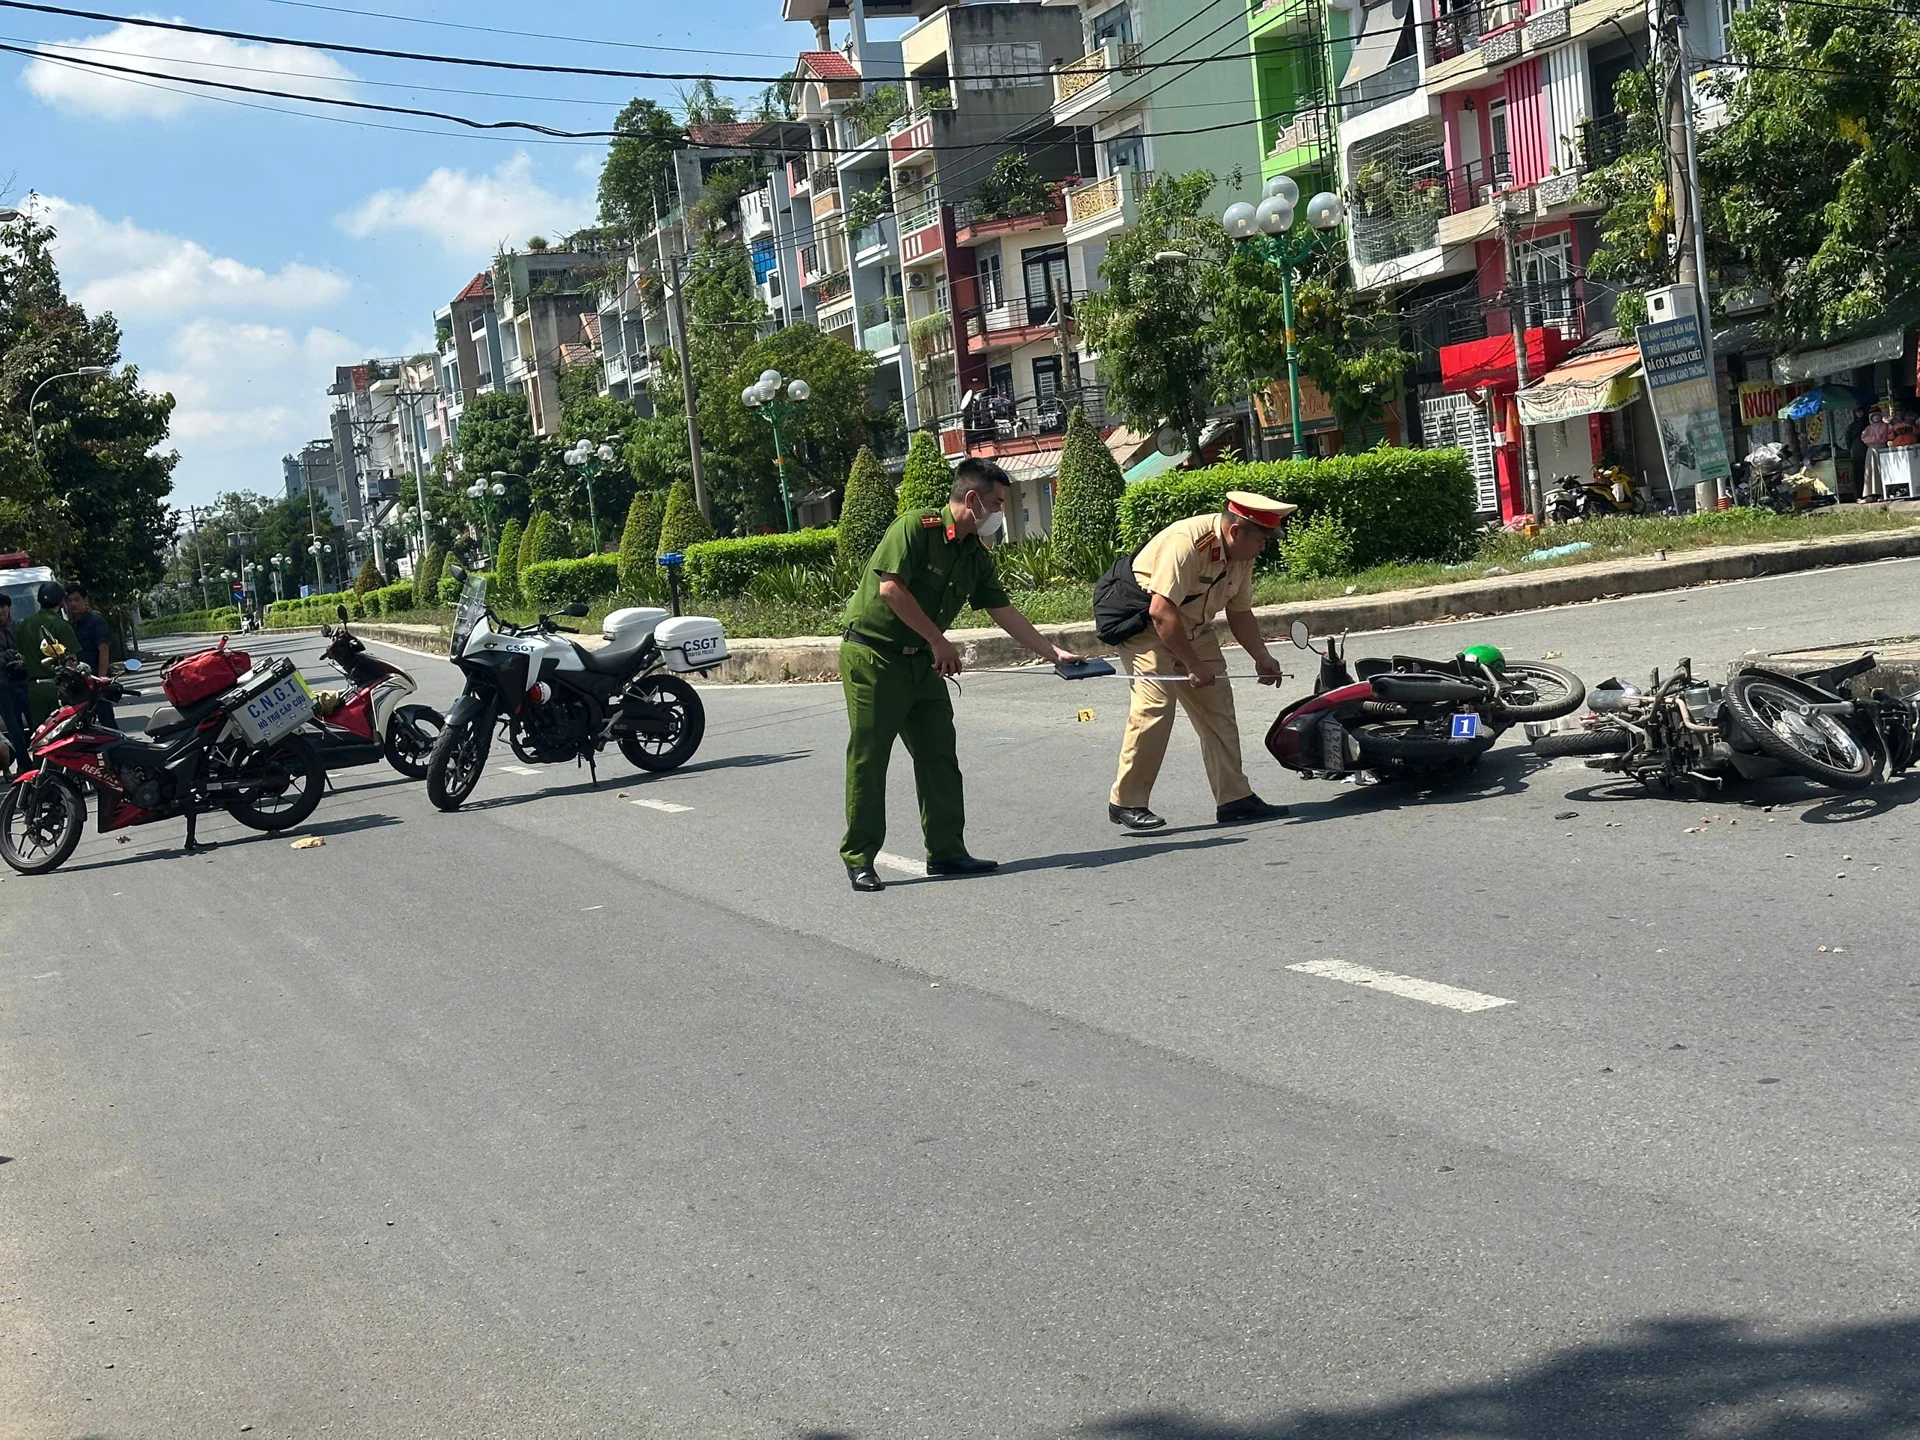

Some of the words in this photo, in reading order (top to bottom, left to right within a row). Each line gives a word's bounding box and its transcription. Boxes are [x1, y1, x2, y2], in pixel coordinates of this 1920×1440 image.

[1665, 357, 1670, 367] 5
[1669, 350, 1688, 366] NGƯỜI
[1687, 346, 1702, 361] CHẾT
[1689, 363, 1706, 378] THÔNG
[1742, 384, 1781, 419] NƯỚC
[506, 644, 535, 653] CSGT
[247, 678, 297, 718] C.N.G.T
[1083, 711, 1091, 722] 3
[1459, 718, 1470, 734] 1
